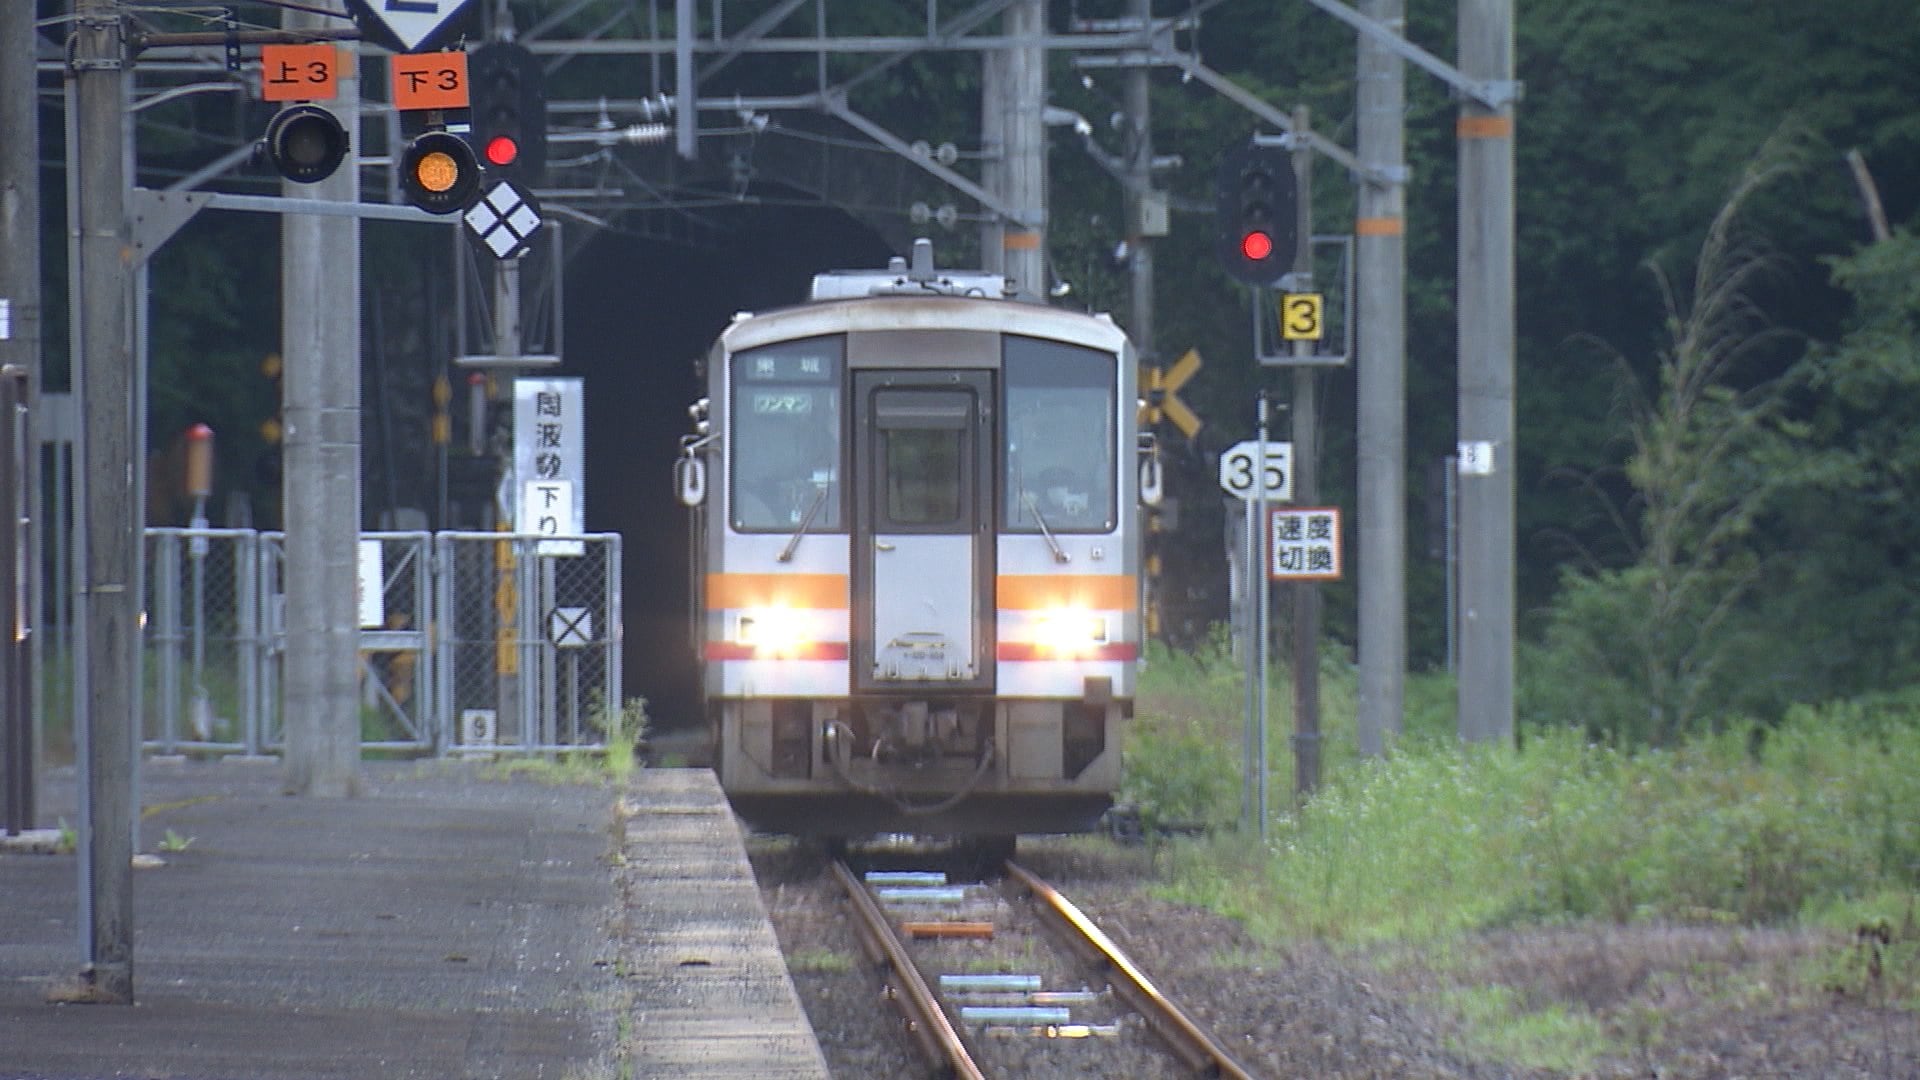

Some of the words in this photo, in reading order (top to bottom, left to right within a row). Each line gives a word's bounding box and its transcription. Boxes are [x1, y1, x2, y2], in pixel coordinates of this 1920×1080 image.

[269, 61, 329, 84] 上3
[400, 69, 459, 93] 下3
[1289, 300, 1316, 333] 3
[1229, 454, 1284, 490] 35
[1278, 515, 1332, 541] 速度
